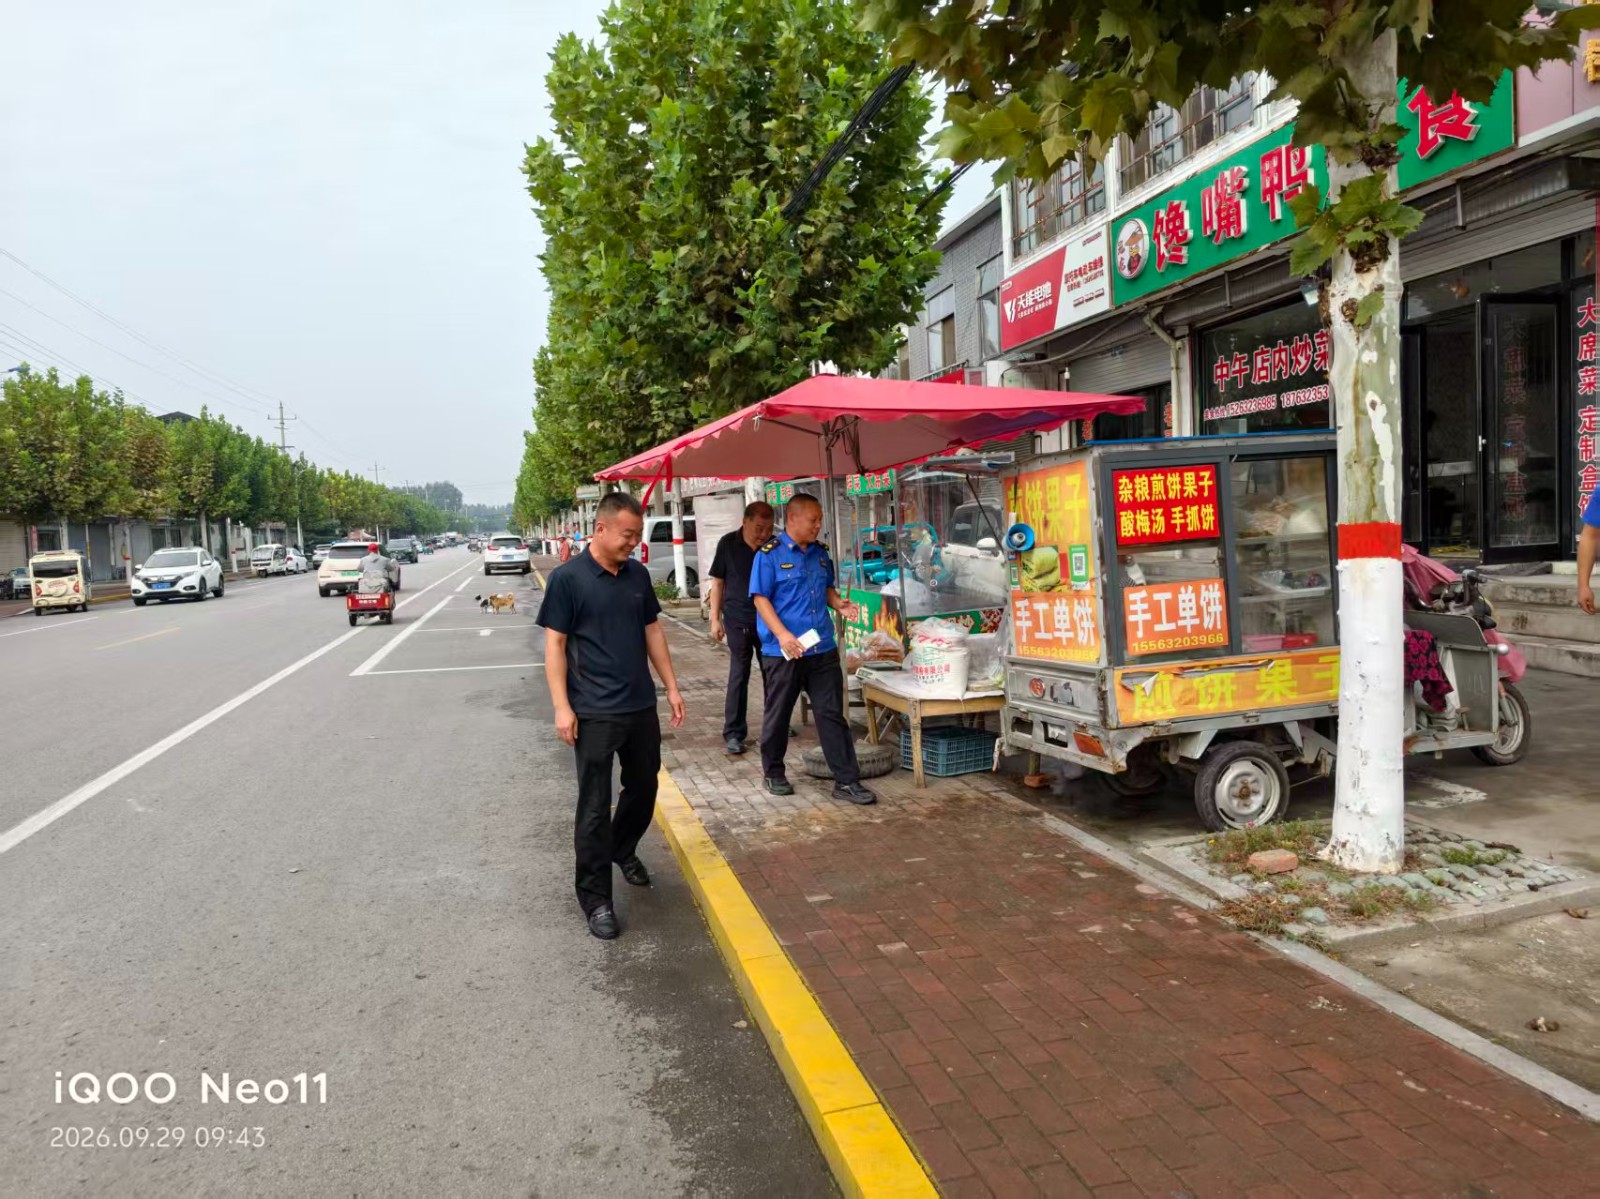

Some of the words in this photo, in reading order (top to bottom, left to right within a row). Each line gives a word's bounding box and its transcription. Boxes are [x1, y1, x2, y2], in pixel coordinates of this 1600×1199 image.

[1118, 470, 1213, 503] 杂粮煎饼果子
[1120, 508, 1165, 537] 酸梅汤
[1170, 503, 1215, 533] 手抓饼
[1014, 597, 1095, 647] 手工单饼
[1128, 582, 1222, 639] 手工单饼
[1132, 633, 1224, 653] 15563203966
